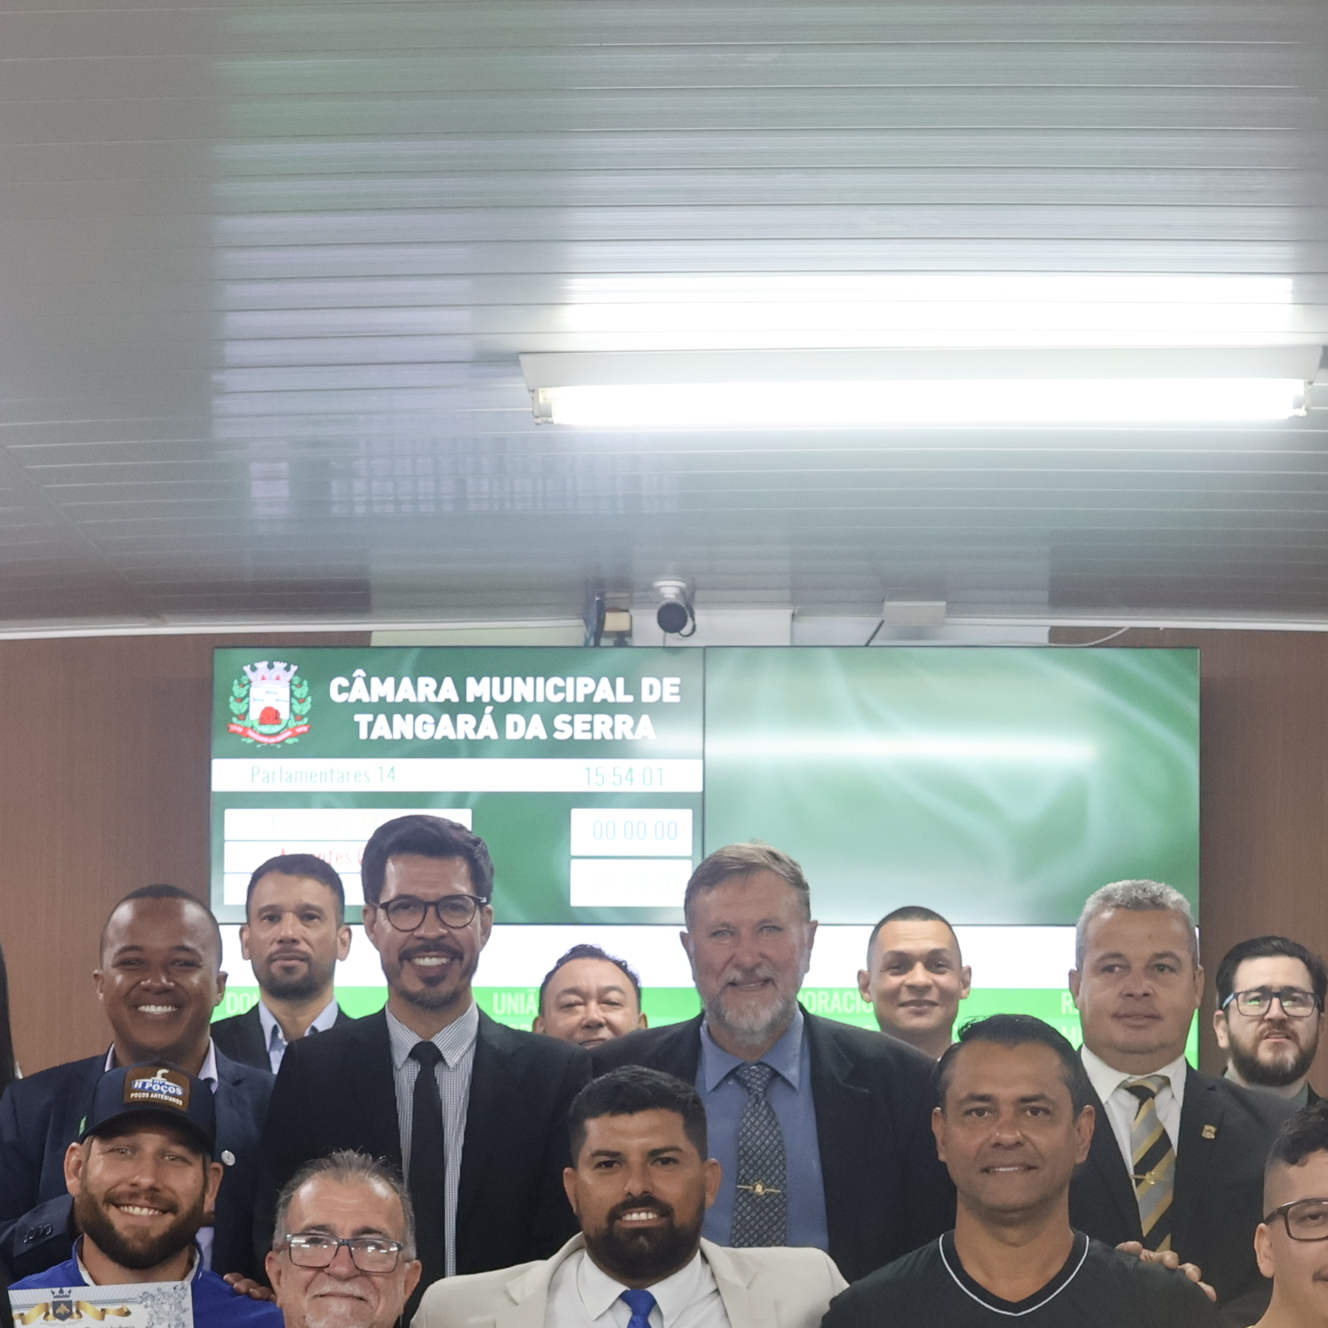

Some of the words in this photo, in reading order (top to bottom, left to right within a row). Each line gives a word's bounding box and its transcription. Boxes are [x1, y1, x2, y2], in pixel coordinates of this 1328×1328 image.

[329, 668, 462, 703] CÂMARA
[465, 676, 634, 703] MUNICIPAL
[645, 677, 681, 703] DE
[354, 706, 499, 740] TANGARÁ
[505, 713, 548, 740] DA
[552, 714, 656, 740] SERRA
[250, 765, 371, 784] Parlamentares
[378, 765, 397, 784] 14
[584, 766, 665, 787] 15:54:01
[493, 989, 538, 1015] UNIÃ
[134, 1081, 142, 1089] H
[145, 1082, 182, 1096] POÇOS
